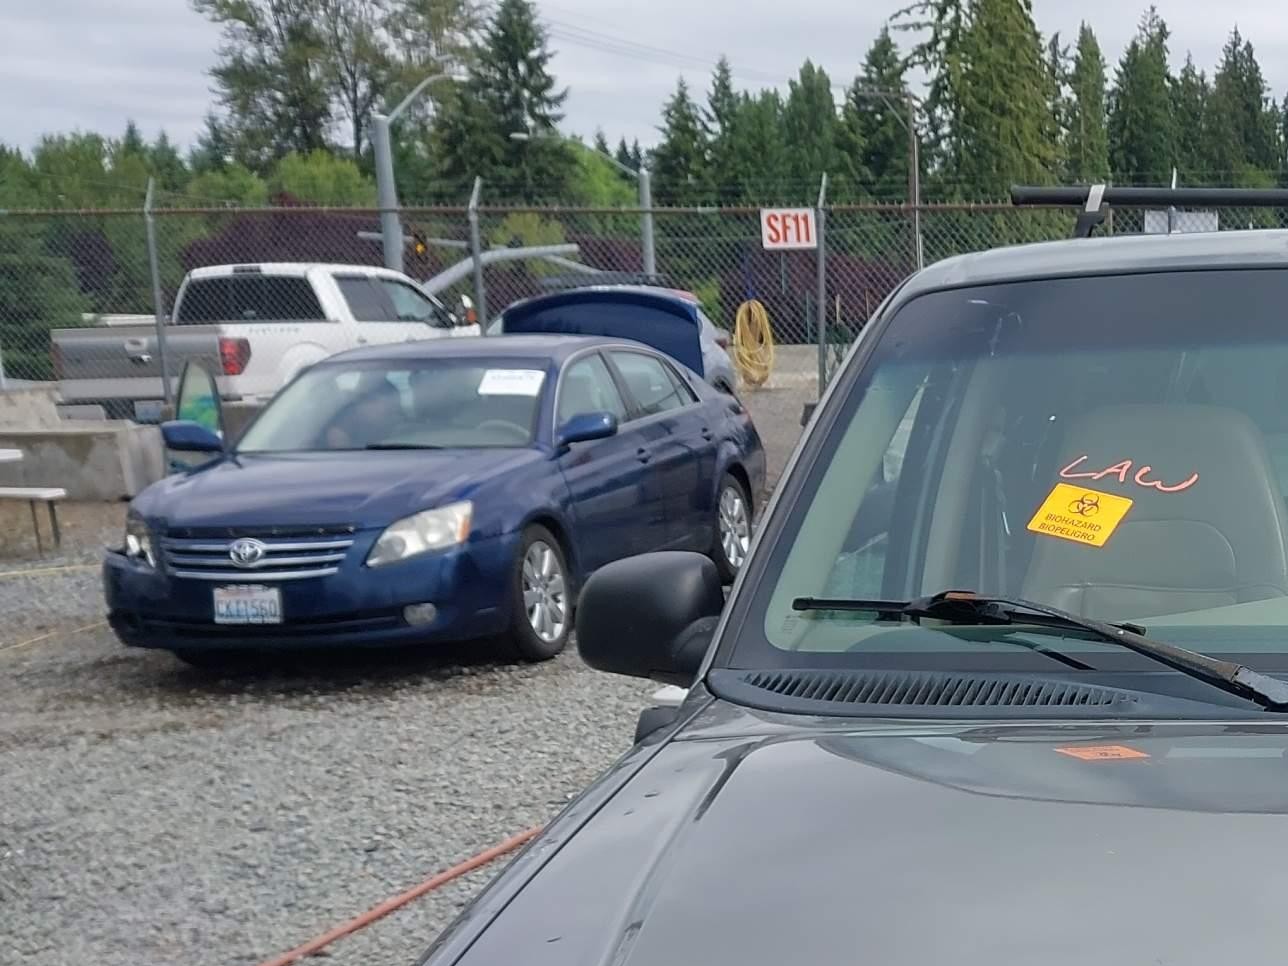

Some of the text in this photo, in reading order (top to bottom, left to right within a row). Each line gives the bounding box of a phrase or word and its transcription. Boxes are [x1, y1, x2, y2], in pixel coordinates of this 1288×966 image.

[766, 213, 811, 243] SF11
[1059, 455, 1199, 492] LAW
[1038, 522, 1096, 541] BIOPELIGRO
[1045, 513, 1102, 532] BIOHAZARD
